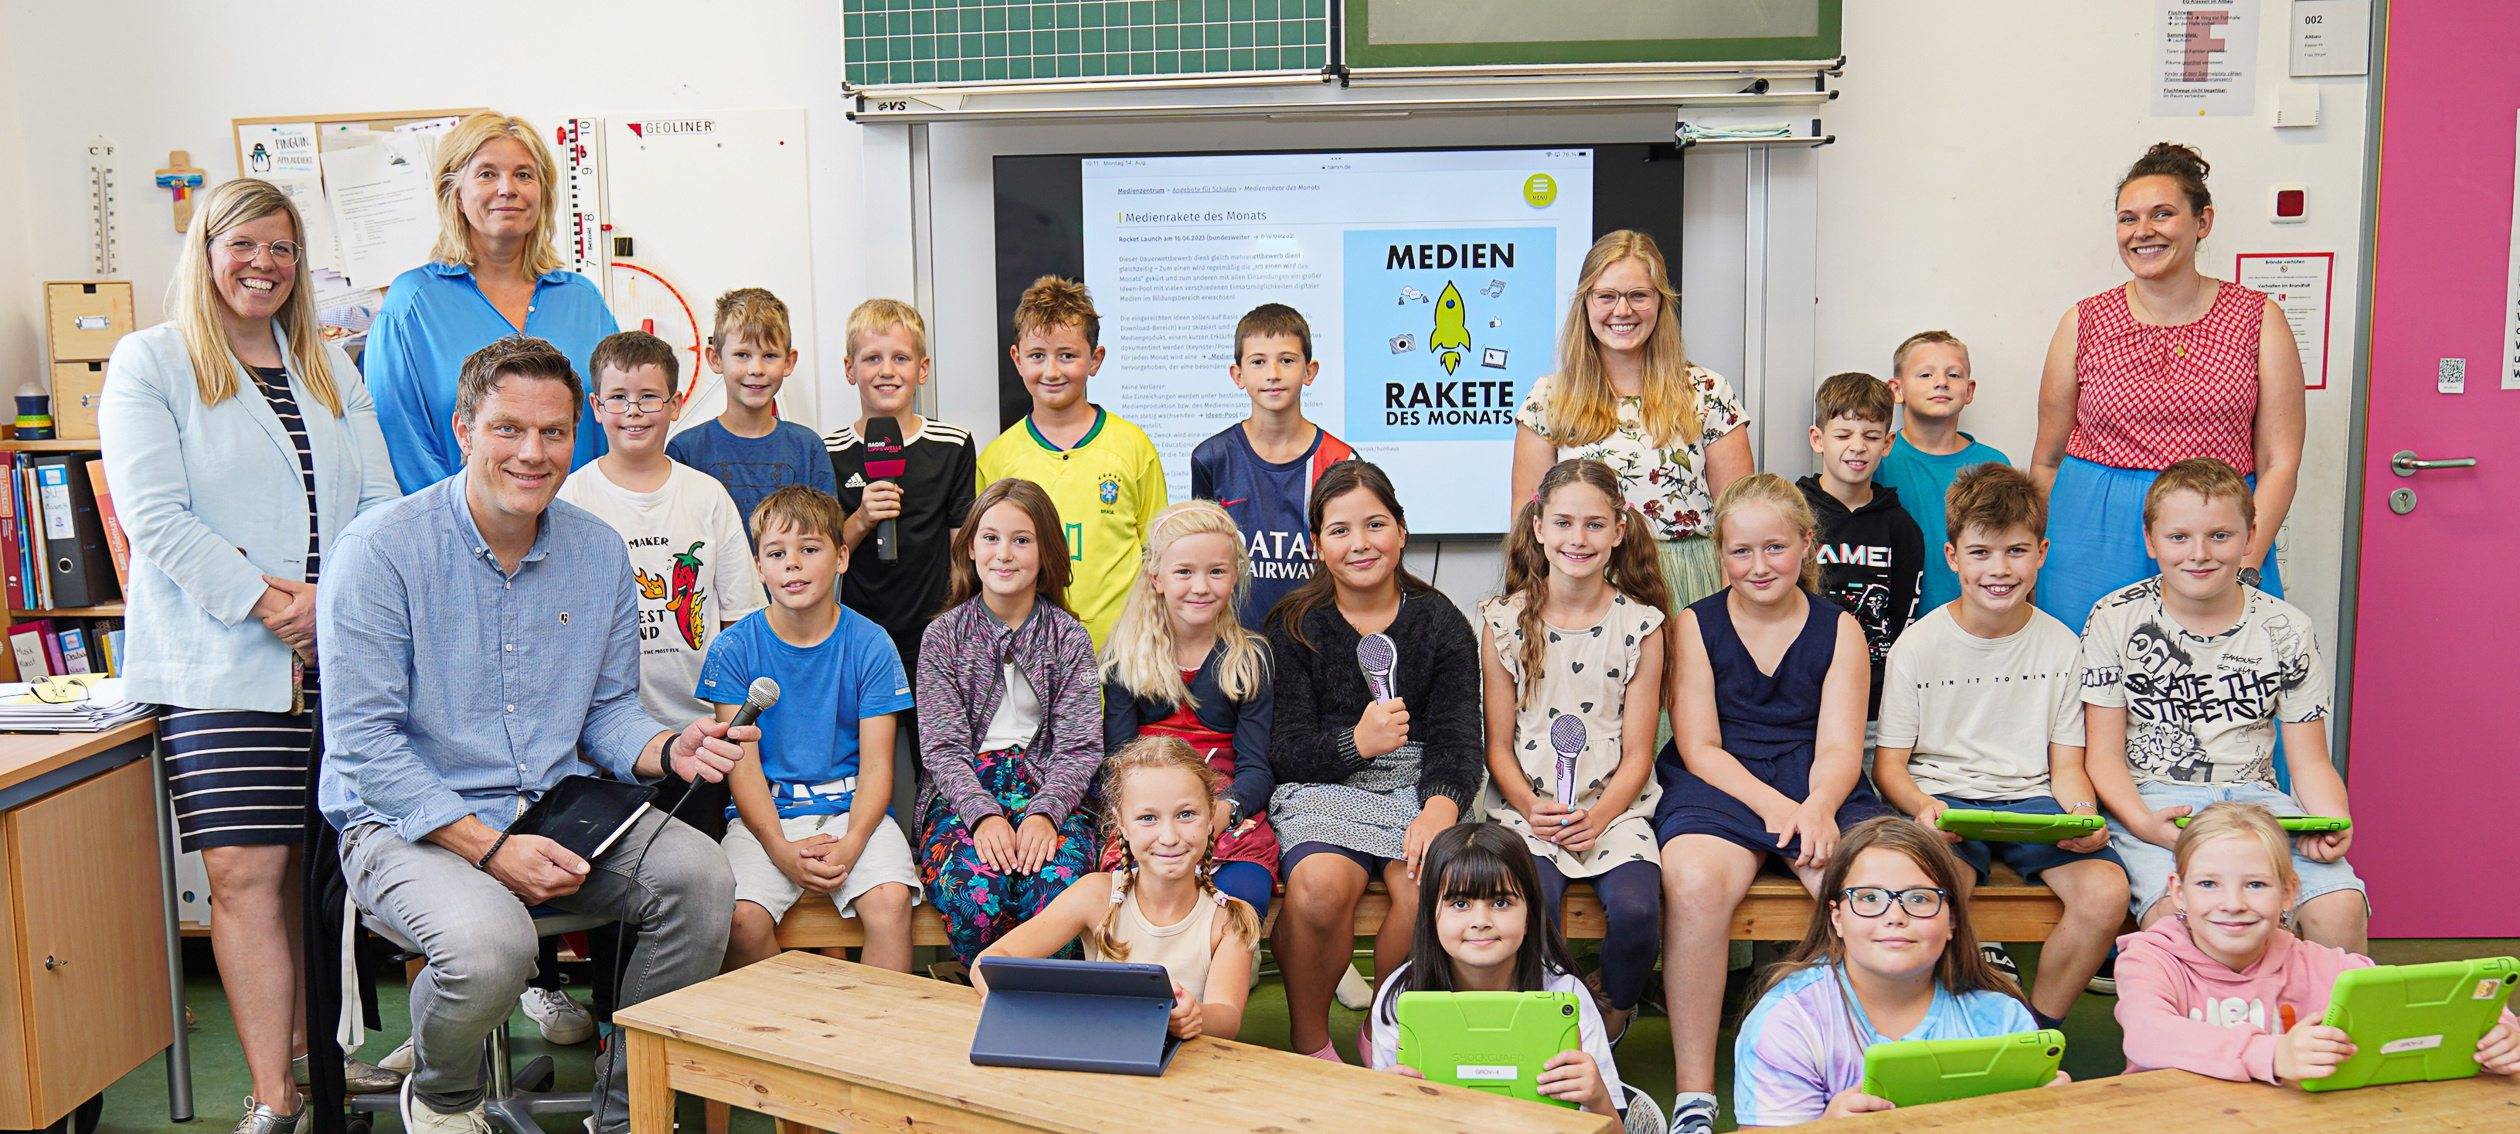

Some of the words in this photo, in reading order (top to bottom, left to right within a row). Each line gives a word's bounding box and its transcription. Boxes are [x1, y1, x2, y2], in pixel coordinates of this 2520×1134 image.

[2304, 15, 2323, 25] 002
[890, 101, 906, 111] VS
[645, 121, 713, 133] GEOLINER
[89, 147, 99, 155] C
[107, 147, 114, 155] F
[1172, 186, 1200, 194] Angebote
[1125, 211, 1200, 223] Medienrakete
[1203, 211, 1223, 221] des
[1226, 211, 1267, 221] Monats
[1386, 243, 1515, 270] MEDIEN
[1385, 381, 1514, 409] RAKETE
[1386, 411, 1420, 426] DES
[1428, 410, 1513, 426] MONATS
[628, 536, 670, 549] MAKER
[1237, 530, 1318, 560] ATA
[1816, 542, 1892, 568] AME
[638, 609, 666, 624] EST
[639, 626, 660, 640] ND
[2022, 673, 2046, 681] WIN
[2124, 670, 2214, 701] SKATE
[2219, 669, 2281, 699] THE
[2131, 697, 2270, 723] STREETS!
[1980, 951, 2016, 969] ILA
